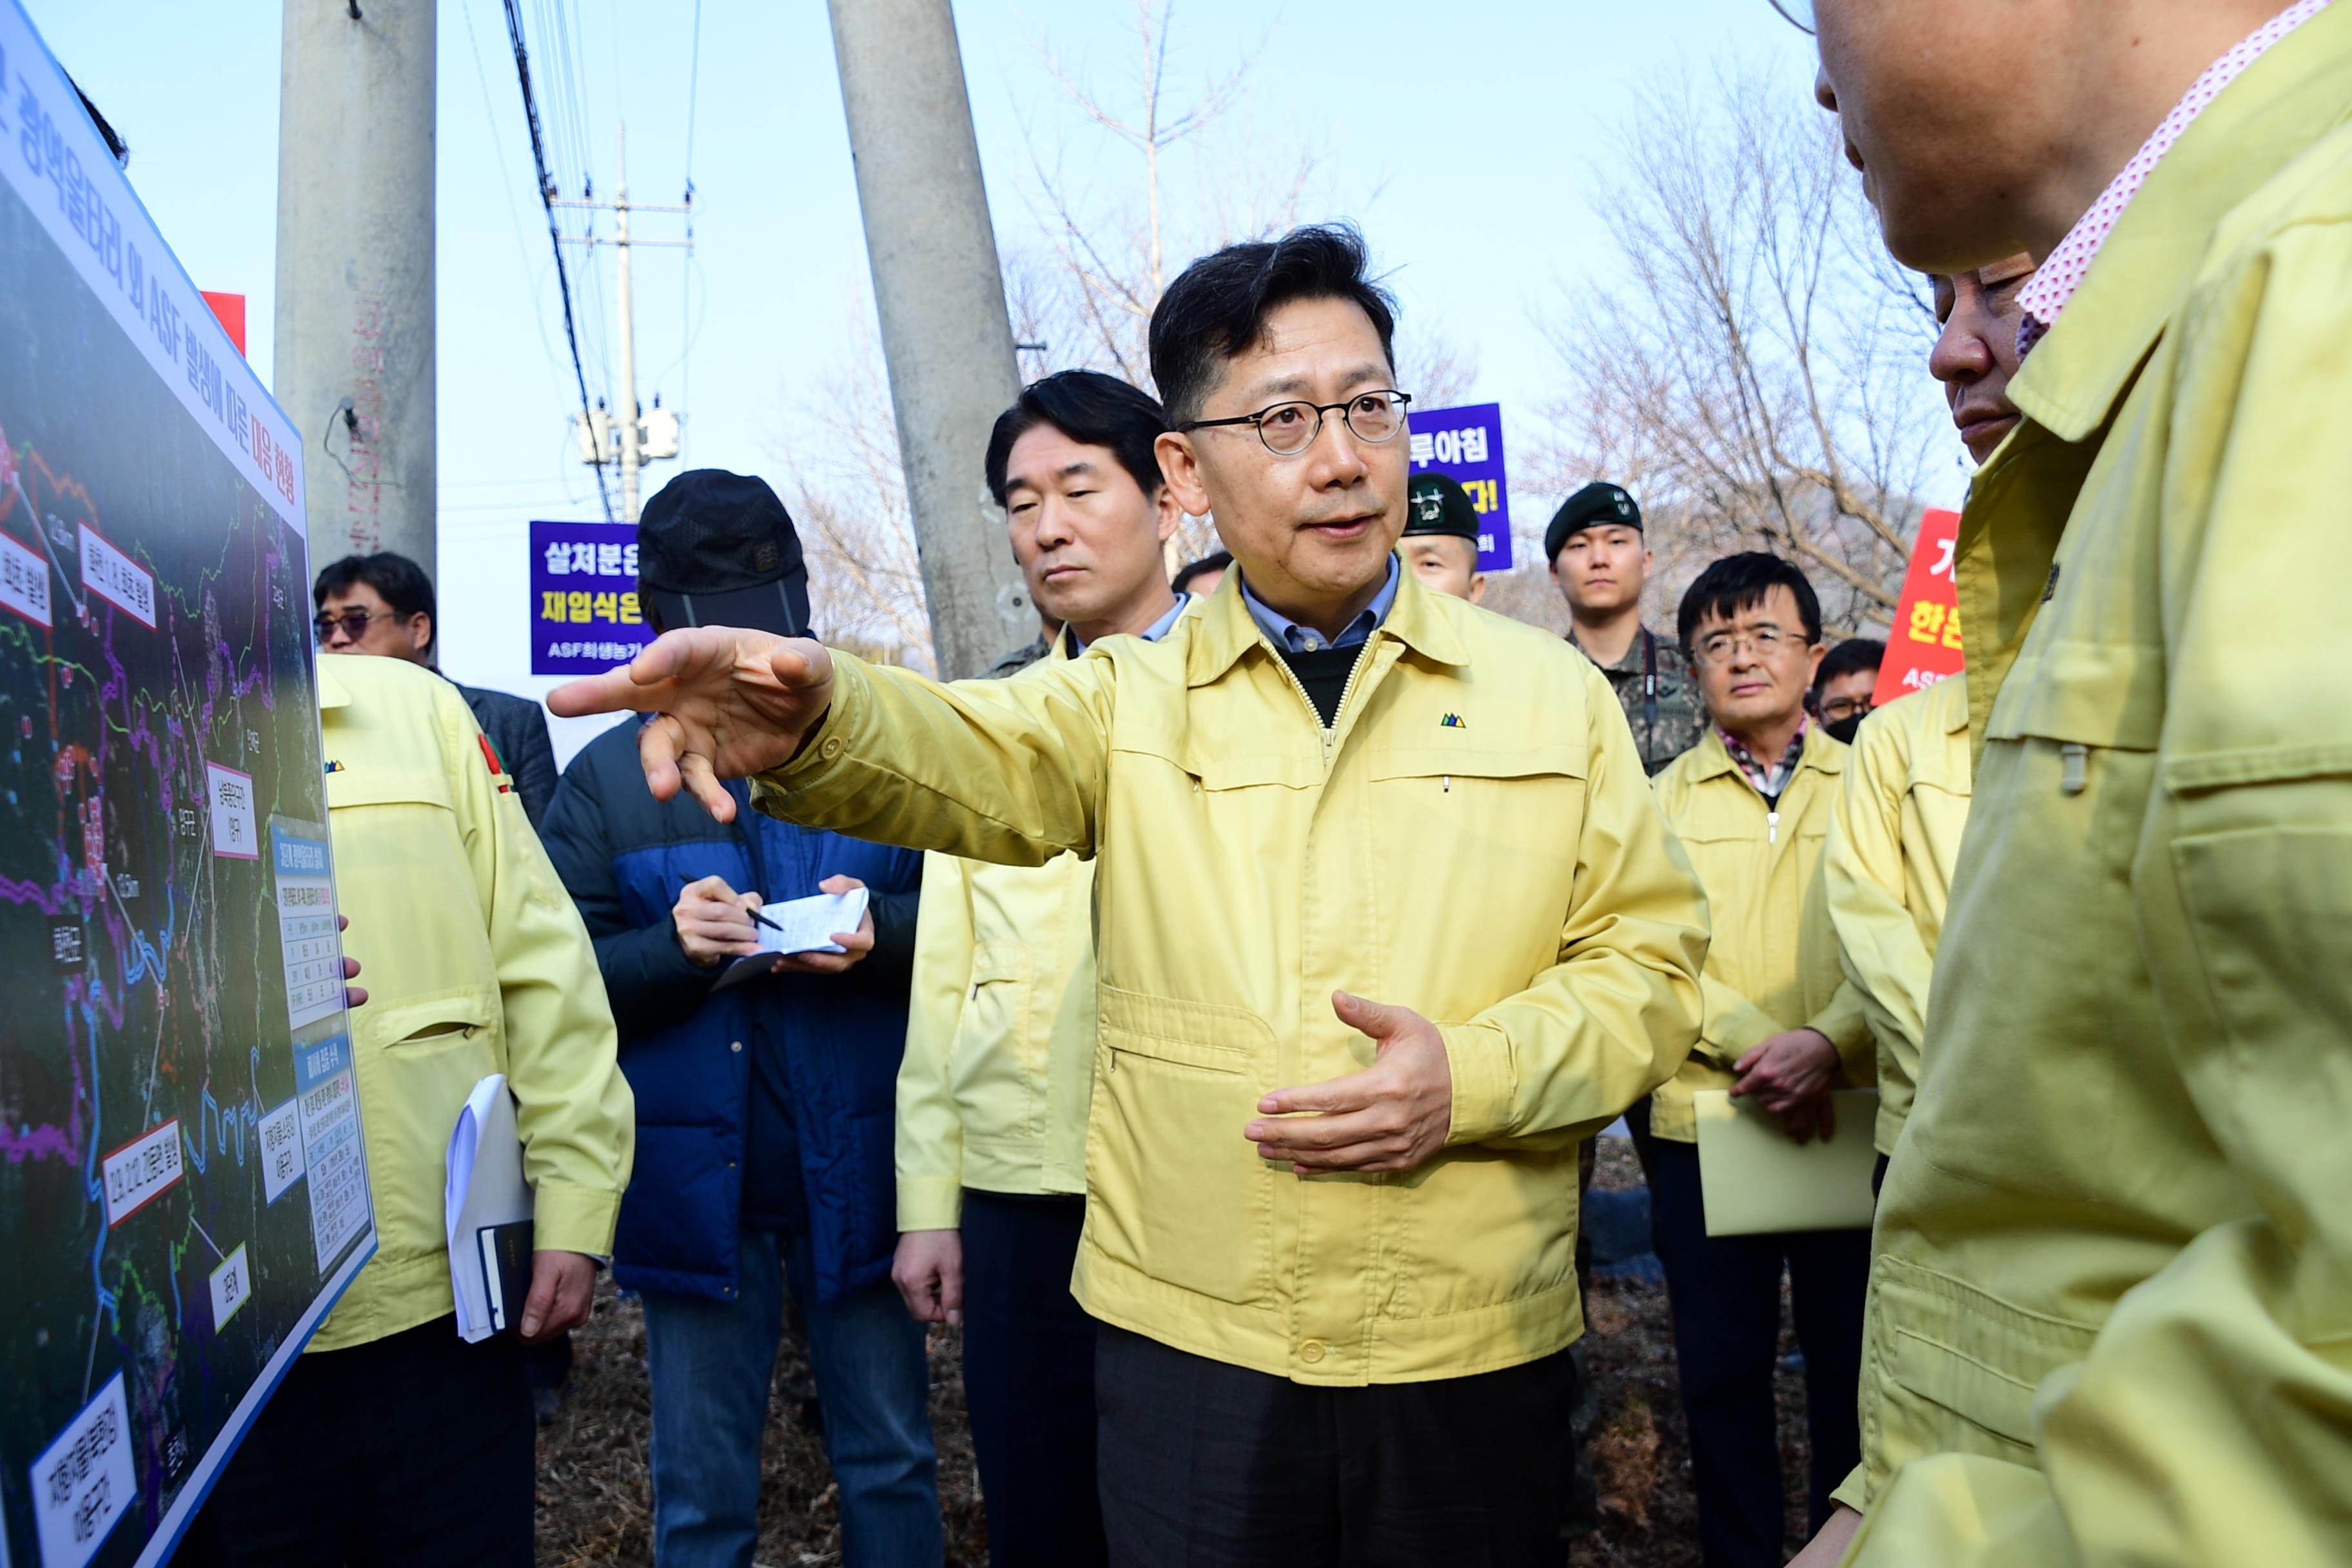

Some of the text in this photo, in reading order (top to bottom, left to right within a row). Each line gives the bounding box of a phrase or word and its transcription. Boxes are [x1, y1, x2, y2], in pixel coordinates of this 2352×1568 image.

[17, 70, 295, 505] 광역울타리 외 ASF 발생에 따른 대응 현황
[540, 591, 643, 625] 재입식은
[54, 926, 82, 963] 화천군
[163, 1133, 179, 1170] 발생
